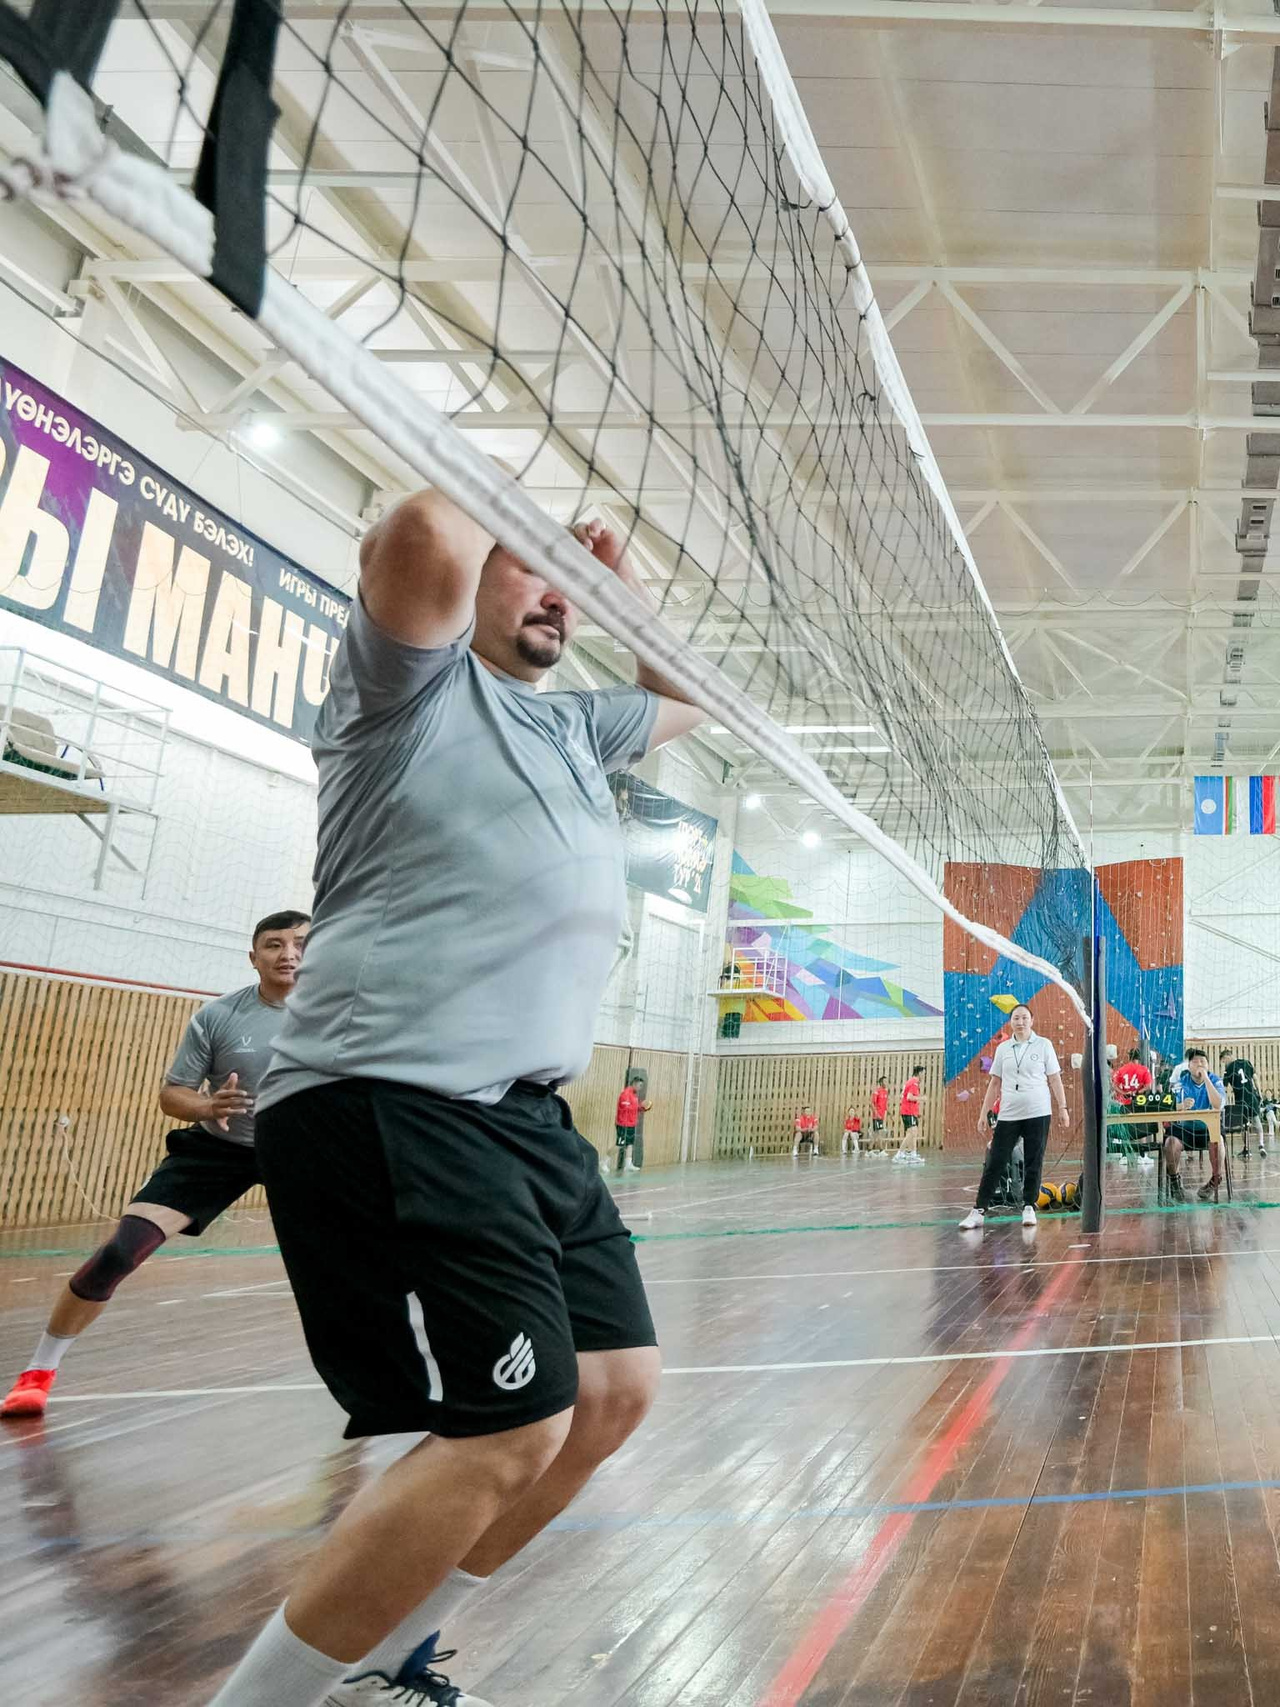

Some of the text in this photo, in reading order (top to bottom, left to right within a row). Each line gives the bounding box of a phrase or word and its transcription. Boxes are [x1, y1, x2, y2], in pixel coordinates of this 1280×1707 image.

[0, 437, 118, 634] Ы
[193, 511, 254, 567] БЭЛЭХ!
[278, 567, 317, 608] ИГРЫ
[1122, 1073, 1140, 1089] 14
[1237, 1068, 1248, 1084] 1
[1136, 1094, 1147, 1106] 9
[1162, 1094, 1173, 1106] 4
